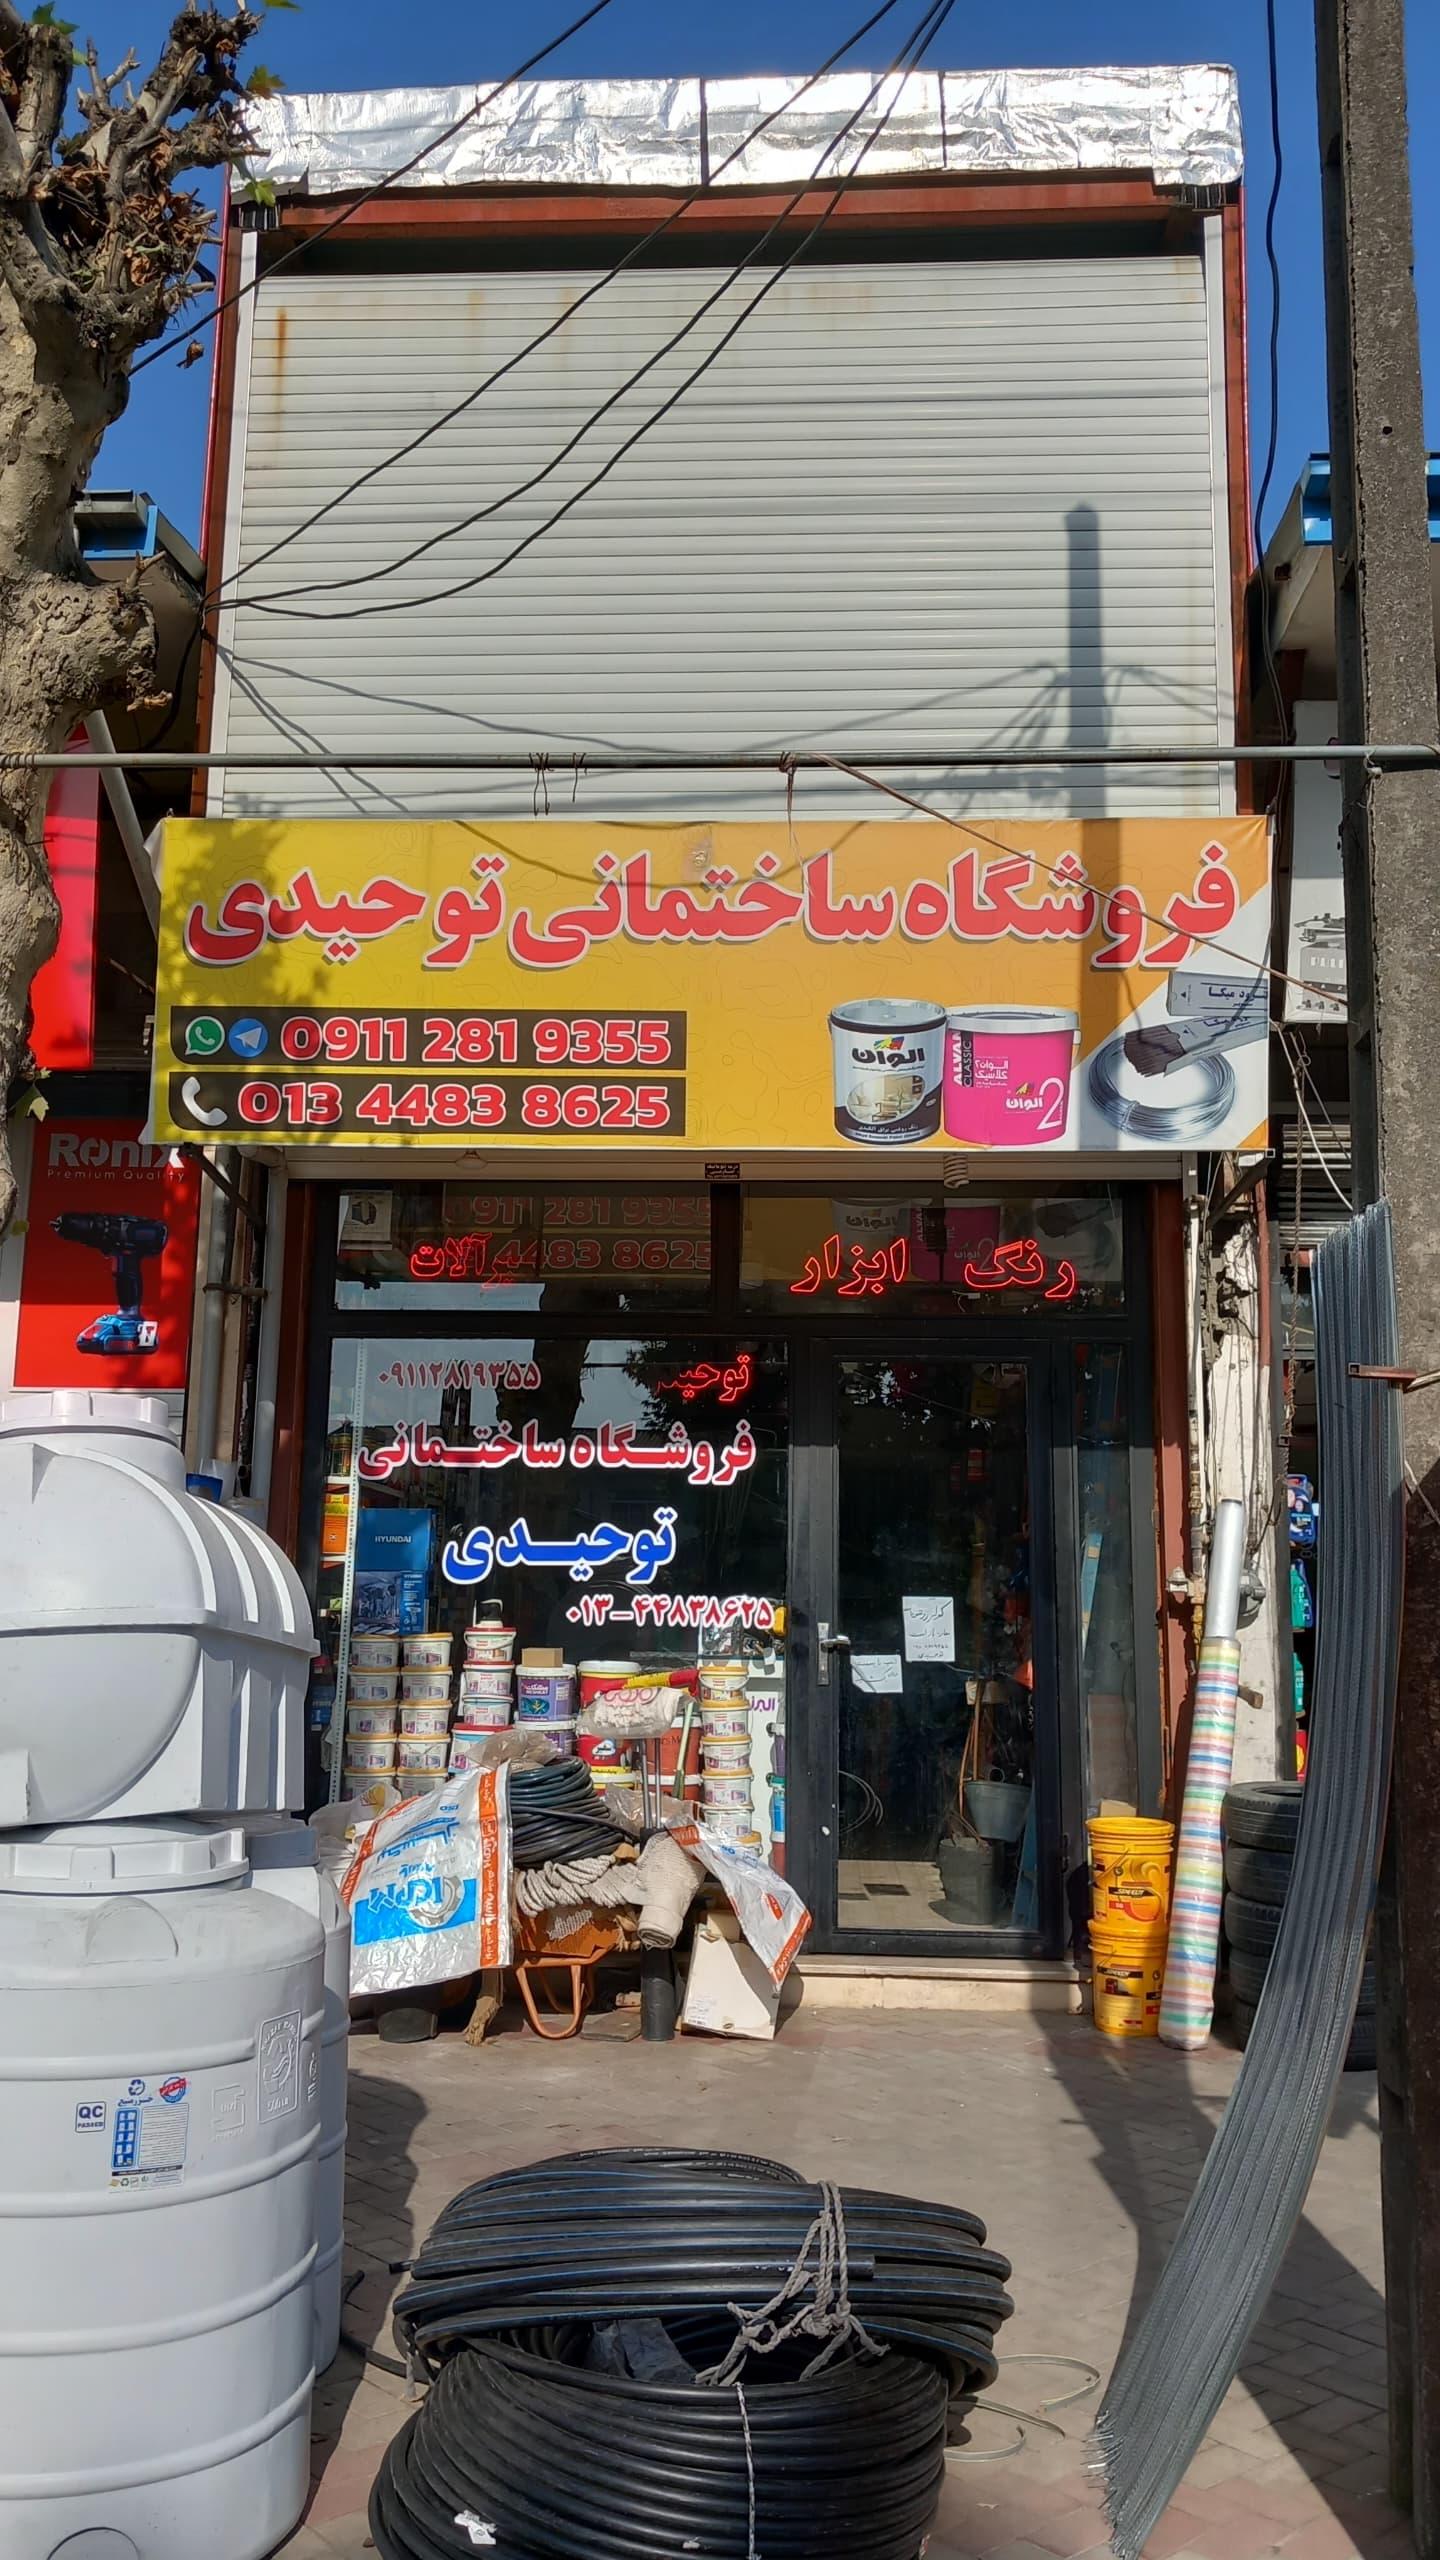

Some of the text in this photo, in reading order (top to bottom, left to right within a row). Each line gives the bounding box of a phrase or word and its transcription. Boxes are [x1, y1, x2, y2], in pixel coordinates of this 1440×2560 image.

[185, 840, 1241, 969] فروشگاه ساختمانی توحیدی
[280, 1016, 671, 1064] 0911 281 9355
[851, 1047, 926, 1068] الوان
[962, 1040, 973, 1088] CLASSIC
[237, 1081, 671, 1128] 013 4483 8625
[1006, 1097, 1043, 1111] الوان
[1036, 1077, 1065, 1130] 2
[48, 1170, 115, 1181] Premium
[790, 1234, 906, 1295] ابزار
[964, 1239, 1076, 1298] رنگ
[378, 1361, 541, 1391] ۰۹۱۱۲۸۱۹۳۵۵
[358, 1419, 757, 1485] فروشگاه ساختمانی
[374, 1535, 412, 1544] HYUNDAI
[442, 1507, 677, 1584] توحیدی
[78, 2105, 104, 2119] QC
